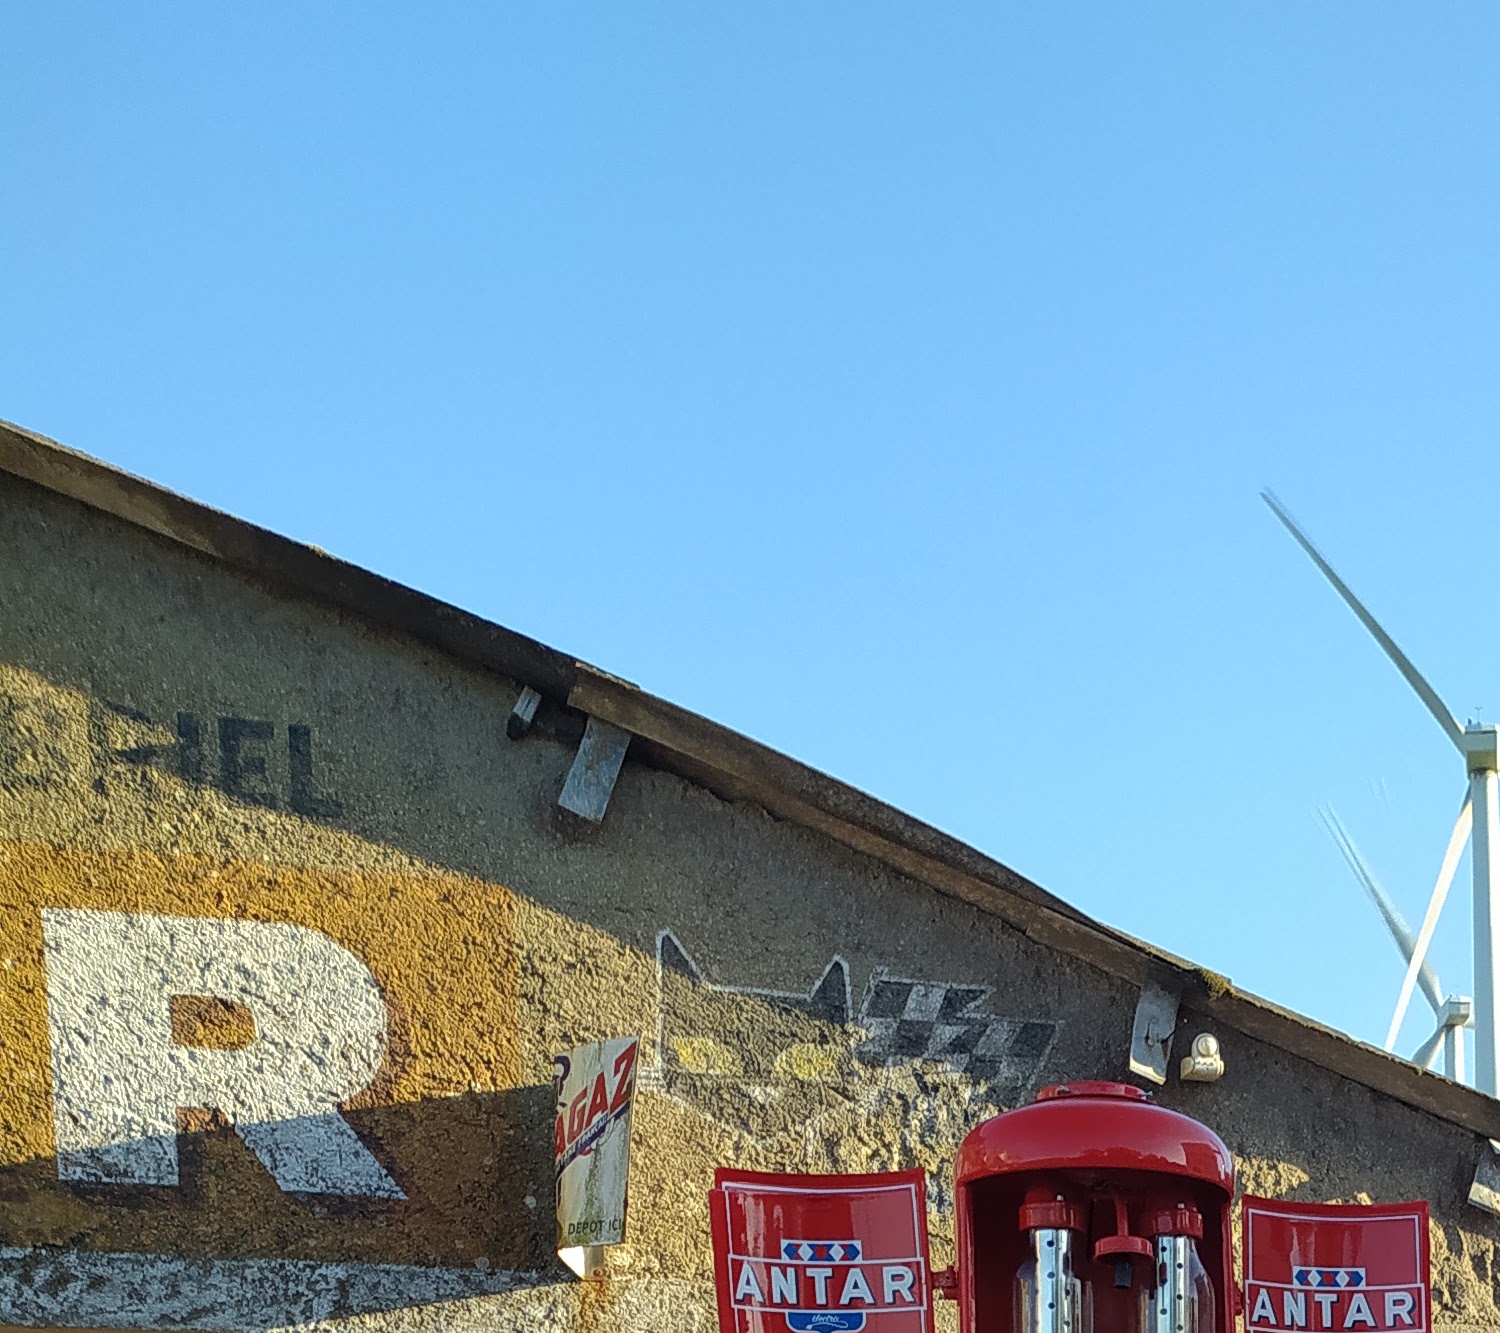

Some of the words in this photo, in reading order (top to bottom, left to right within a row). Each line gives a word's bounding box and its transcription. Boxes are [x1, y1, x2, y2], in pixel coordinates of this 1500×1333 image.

[42, 908, 408, 1200] R
[568, 1219, 605, 1235] DEPOT
[735, 1262, 916, 1306] ANTAR
[1251, 1287, 1418, 1330] ANTAR
